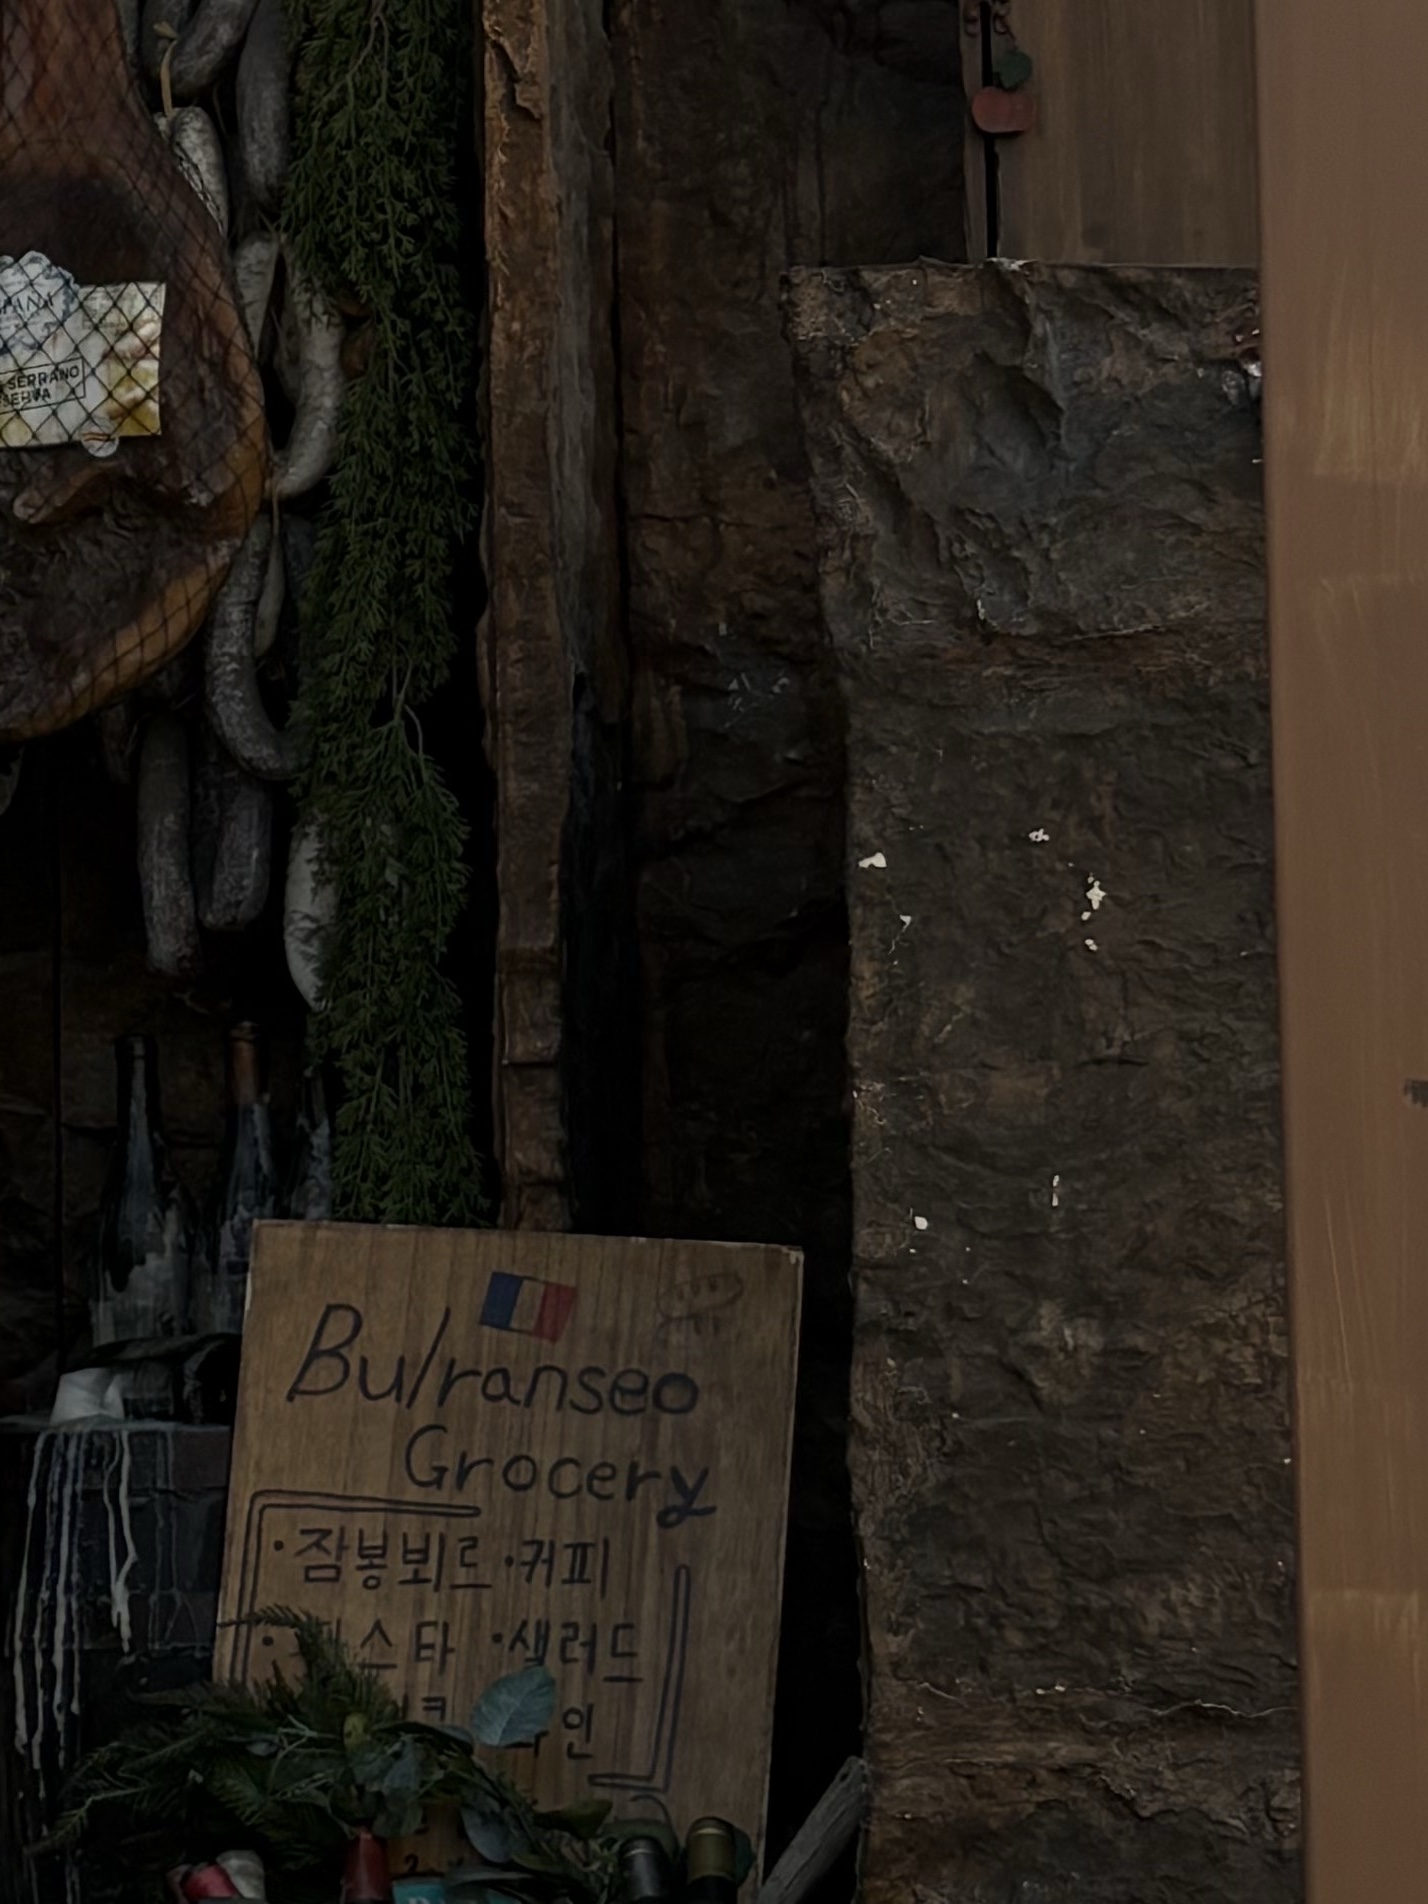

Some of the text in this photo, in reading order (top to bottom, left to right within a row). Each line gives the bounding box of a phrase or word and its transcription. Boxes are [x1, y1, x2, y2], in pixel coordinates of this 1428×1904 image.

[7, 365, 80, 391] SERRANO
[286, 1303, 700, 1417] Bulranseo
[404, 1425, 717, 1529] Grocery
[517, 1536, 611, 1600] 커피
